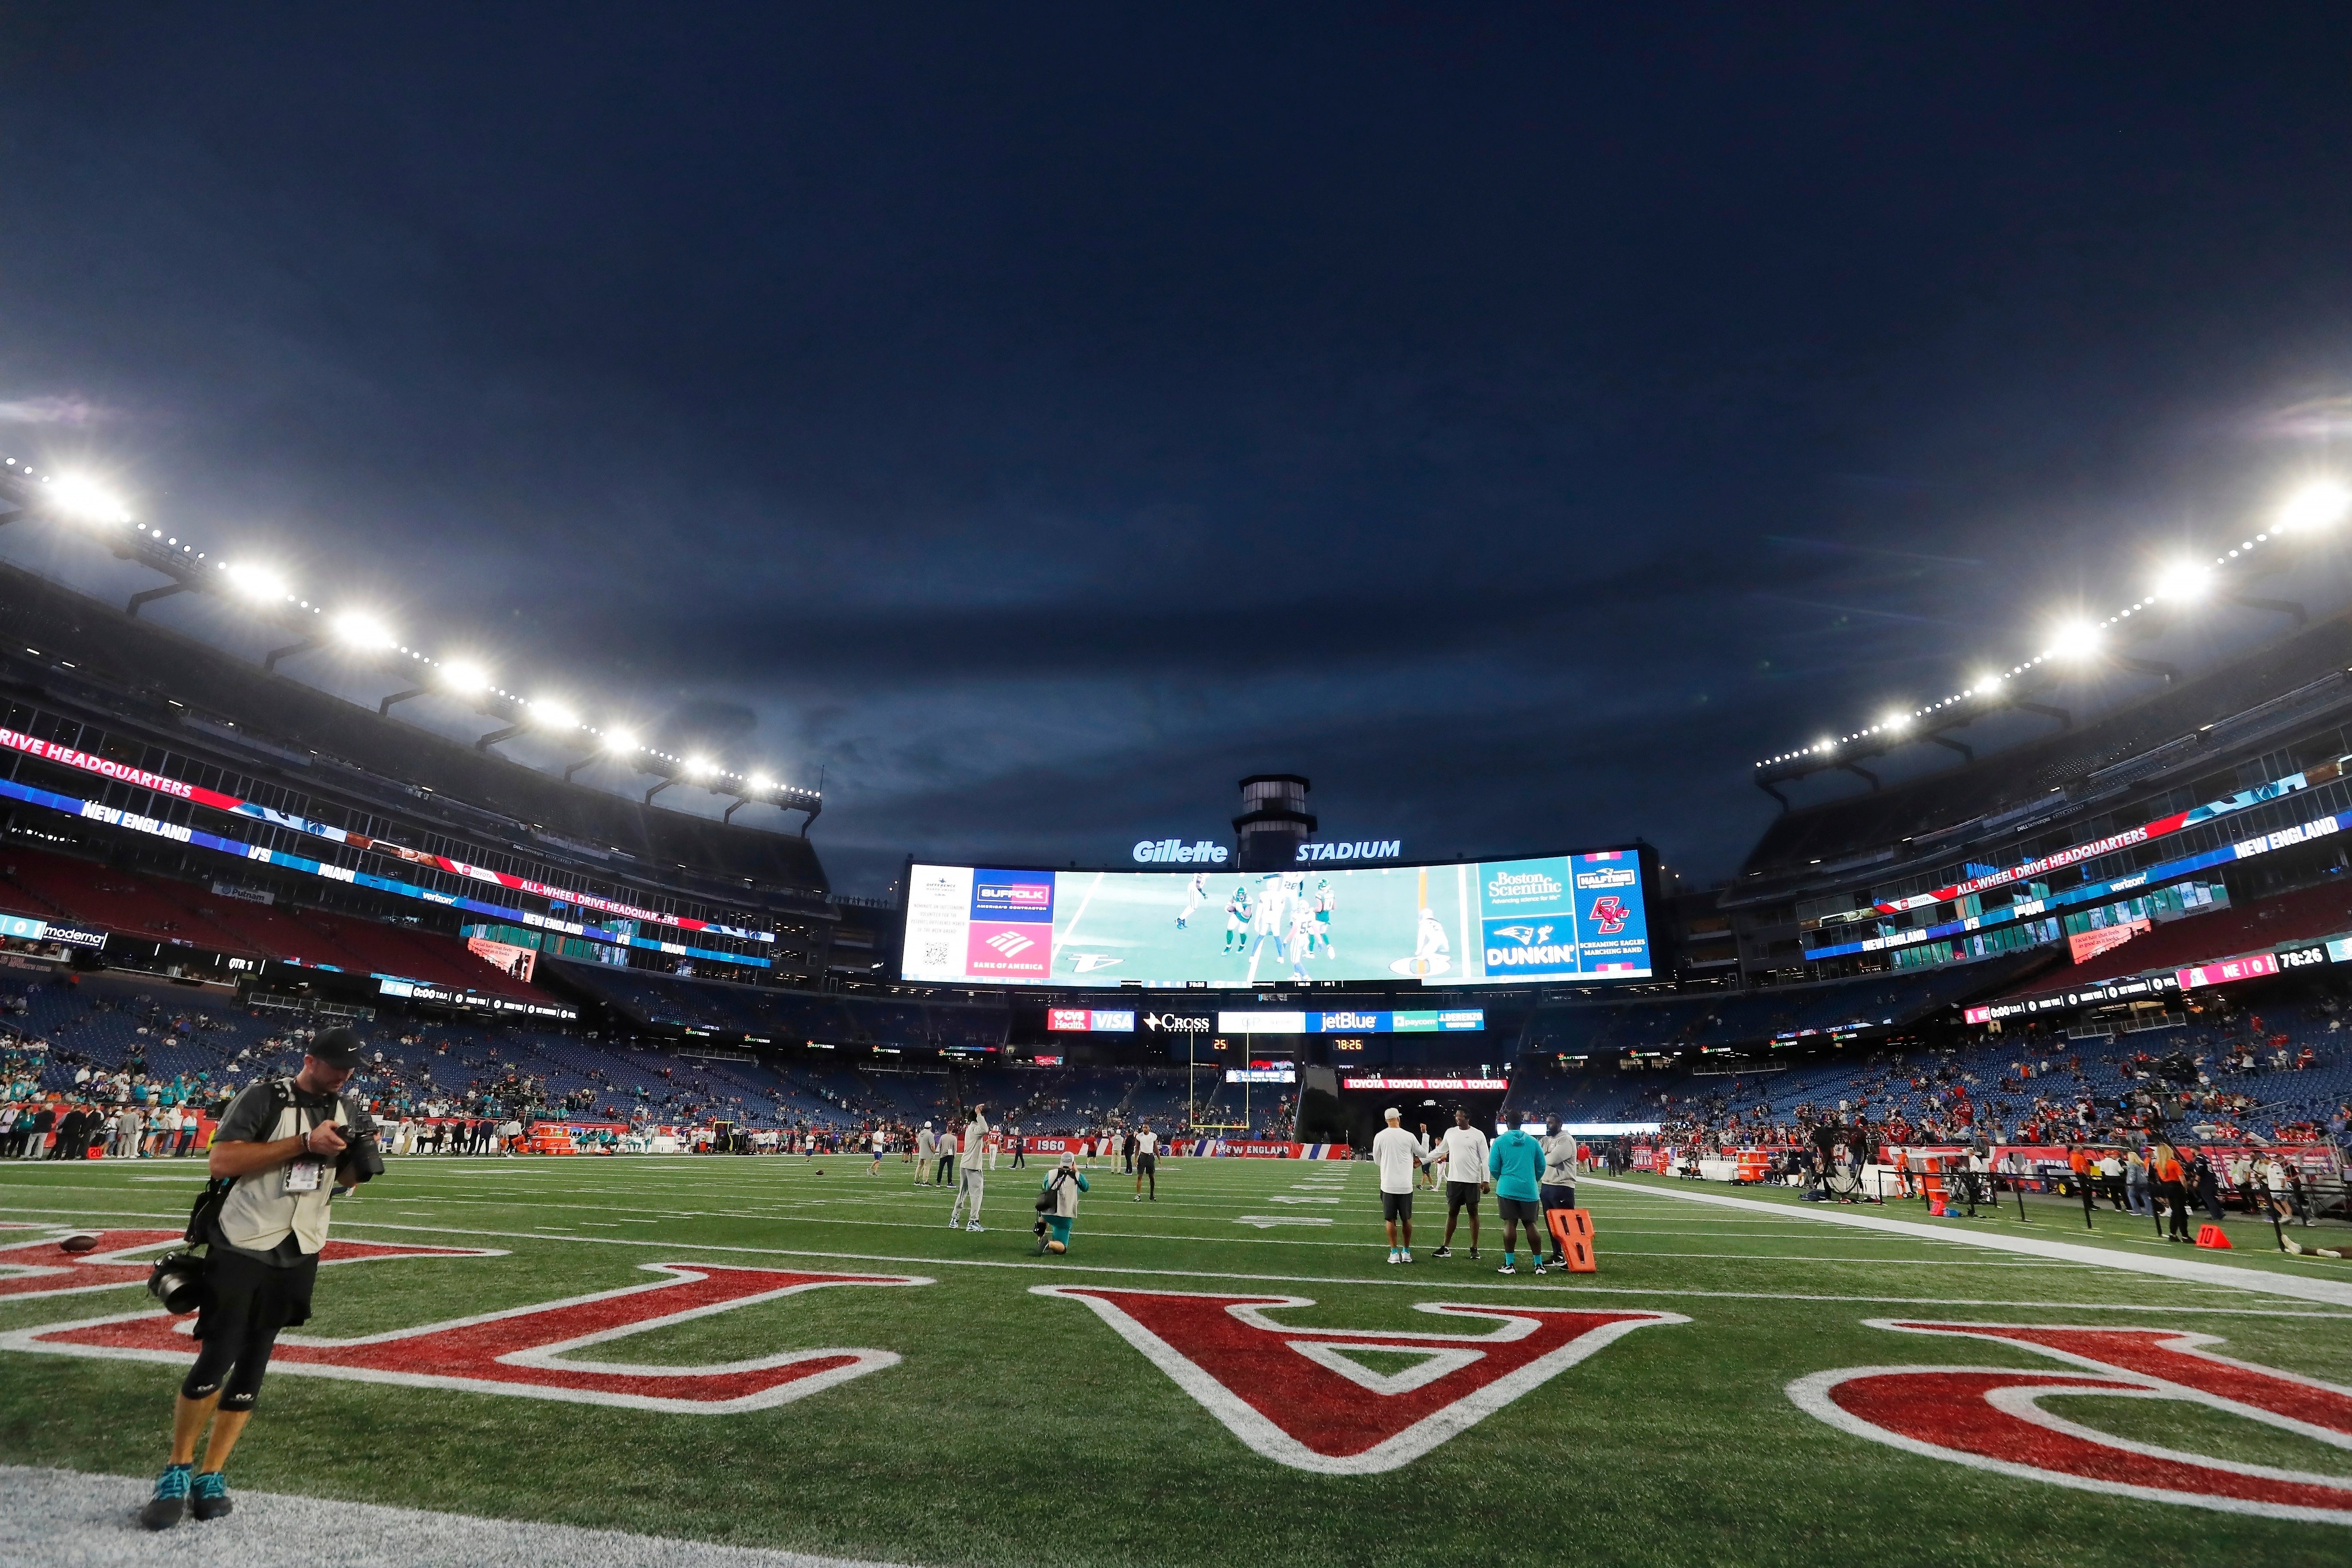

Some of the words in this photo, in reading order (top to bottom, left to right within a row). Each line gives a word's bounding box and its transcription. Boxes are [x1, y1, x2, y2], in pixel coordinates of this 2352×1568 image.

[46, 744, 192, 798] HEADQUARTERS
[81, 802, 122, 824] NEW
[121, 812, 192, 842] ENGLAND
[2233, 836, 2269, 859] NEW
[2267, 816, 2339, 850] ENGLAND
[248, 845, 272, 863] VS
[1133, 839, 1228, 863] Gillette
[1296, 840, 1400, 861] STADIUM
[318, 863, 355, 883] MIAMI
[1910, 897, 1929, 905] TOYOTA
[1957, 870, 2015, 896] ALL-WHEEL
[2015, 859, 2048, 878] DRIVE
[2049, 827, 2148, 869] HEADQUARTERS
[1284, 881, 1297, 889] 28
[1497, 872, 1544, 885] Boston
[1581, 874, 1631, 885] HALFTIME
[2110, 876, 2143, 892] verizon
[473, 870, 492, 879] TOYOTA
[520, 880, 576, 903] ALL-WHEEL
[578, 895, 606, 910] DRIVE
[981, 889, 1043, 899] SUFFOLK
[1488, 877, 1562, 897] Scientific
[233, 888, 265, 901] Putnam
[423, 892, 452, 905] verizon
[2013, 900, 2045, 919] MIAMI
[523, 912, 544, 926] NEW
[544, 918, 584, 936] ENGLAND
[1964, 917, 1980, 931] VS
[44, 926, 103, 944] moderna
[616, 934, 630, 946] VS
[1862, 937, 1885, 951] NEW
[1885, 929, 1927, 948] ENGLAND
[661, 942, 686, 956] MIAMI
[229, 958, 246, 969] QTR
[248, 961, 253, 970] 1
[2222, 964, 2240, 978] NE
[2252, 960, 2263, 973] 0
[2280, 948, 2323, 968] 78:26
[413, 987, 435, 999] 0:00
[1978, 1010, 1989, 1020] NE
[1991, 1005, 2010, 1018] 0:00
[2039, 1000, 2052, 1008] PASS
[2051, 998, 2061, 1006] YDS
[2093, 990, 2104, 999] YDS
[1064, 1011, 1085, 1020] CVS
[1093, 1014, 1133, 1029] VISA
[1320, 1012, 1376, 1032] jetBlue
[1214, 1039, 1226, 1049] 25
[1335, 1040, 1362, 1050] 78:26
[1348, 1079, 1384, 1089] TOYOTA
[1387, 1079, 1424, 1089] TOYOTA
[1427, 1079, 1464, 1089] TOYOTA
[1466, 1079, 1504, 1089] TOYOTA
[1007, 1138, 1033, 1150] ET.
[1037, 1139, 1065, 1151] 1960
[1225, 1145, 1243, 1154] EW
[1247, 1145, 1289, 1155] ENGLAND
[91, 1148, 101, 1157] 20
[1916, 1177, 1922, 1189] G
[2201, 1228, 2213, 1244] 10
